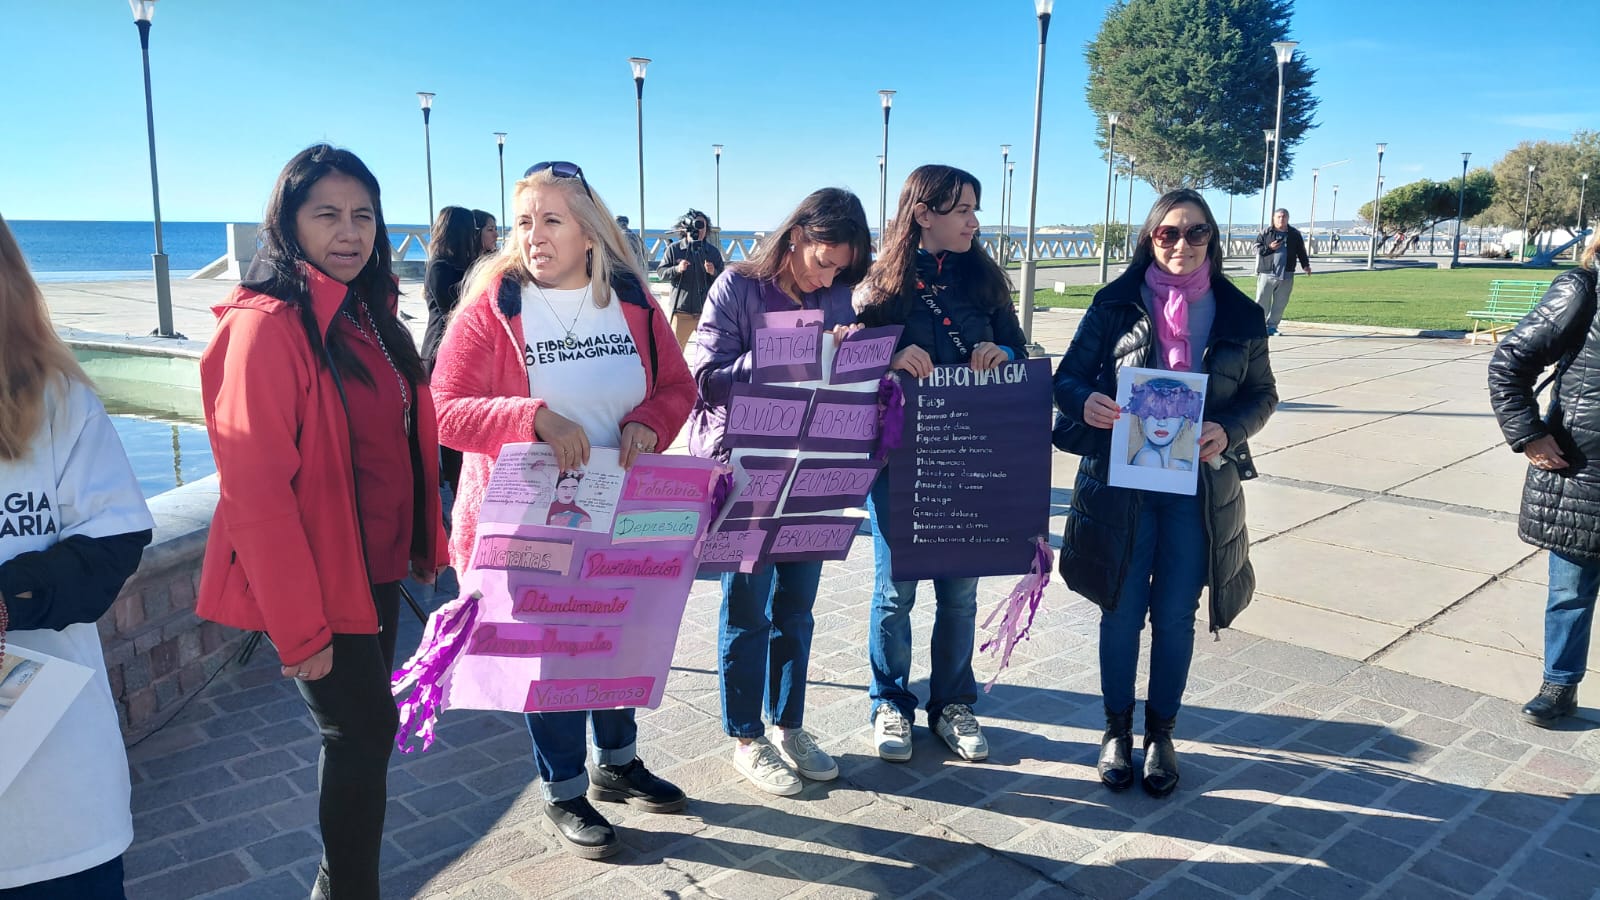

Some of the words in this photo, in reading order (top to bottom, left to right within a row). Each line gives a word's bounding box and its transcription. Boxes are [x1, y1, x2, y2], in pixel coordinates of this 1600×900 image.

[921, 294, 942, 315] Love
[537, 334, 632, 352] FIBROMIALGIA
[758, 333, 815, 359] FATIGA
[948, 331, 967, 355] Love
[540, 353, 555, 364] ES
[560, 345, 637, 361] IMAGINARIA
[839, 341, 892, 367] INSOMNIO
[918, 395, 945, 408] Fatiga
[730, 402, 797, 431] OLVIDO
[917, 411, 947, 421] Insomnio
[949, 410, 968, 419] diario
[916, 422, 940, 432] Brotes
[916, 434, 941, 445] Rigidez
[943, 434, 949, 442] al
[959, 445, 967, 454] de
[916, 457, 935, 466] Mala
[795, 470, 870, 492] ZUMBIDO
[917, 469, 955, 478] Intestino
[914, 492, 952, 505] Letargo
[618, 515, 695, 536] Depresión
[913, 522, 954, 530] Intolerancia
[737, 531, 752, 541] DE
[777, 528, 851, 548] BRUXISMO
[913, 534, 965, 543] Articulaciones
[476, 537, 553, 569] Migrañas
[704, 542, 730, 551] MASA
[536, 686, 579, 706] Visión
[585, 684, 645, 704] Borrosa
